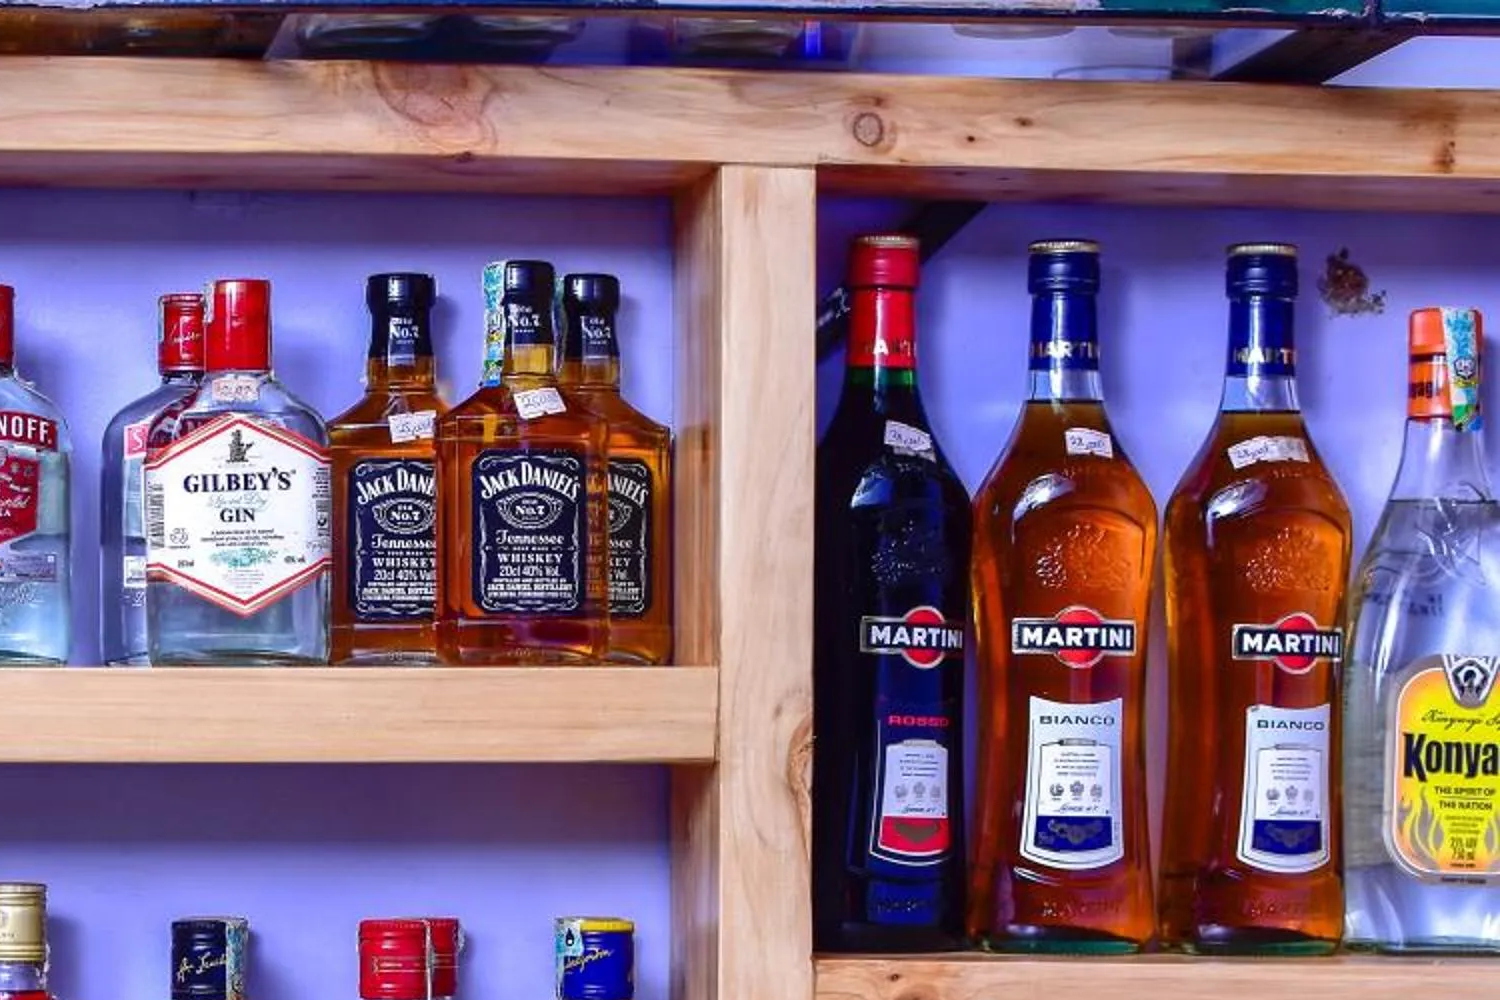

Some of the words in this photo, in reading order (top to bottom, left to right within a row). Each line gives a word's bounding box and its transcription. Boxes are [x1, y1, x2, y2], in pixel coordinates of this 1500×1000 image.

[183, 467, 293, 493] GILBEY'S
[355, 473, 396, 505] JACK
[480, 466, 521, 500] JACK
[520, 460, 582, 502] DANIEL'S
[219, 507, 256, 523] GIN
[495, 529, 566, 547] Tennessee
[497, 553, 563, 564] WHISKEY
[870, 625, 964, 649] MARTINI
[1021, 626, 1133, 648] MARTINI
[1242, 632, 1340, 655] MARTINI
[887, 714, 951, 727] ROSSO
[1039, 714, 1116, 726] BIANCO
[1256, 719, 1326, 731] BIANCO
[1402, 732, 1500, 783] Konya
[1457, 800, 1494, 811] NATION
